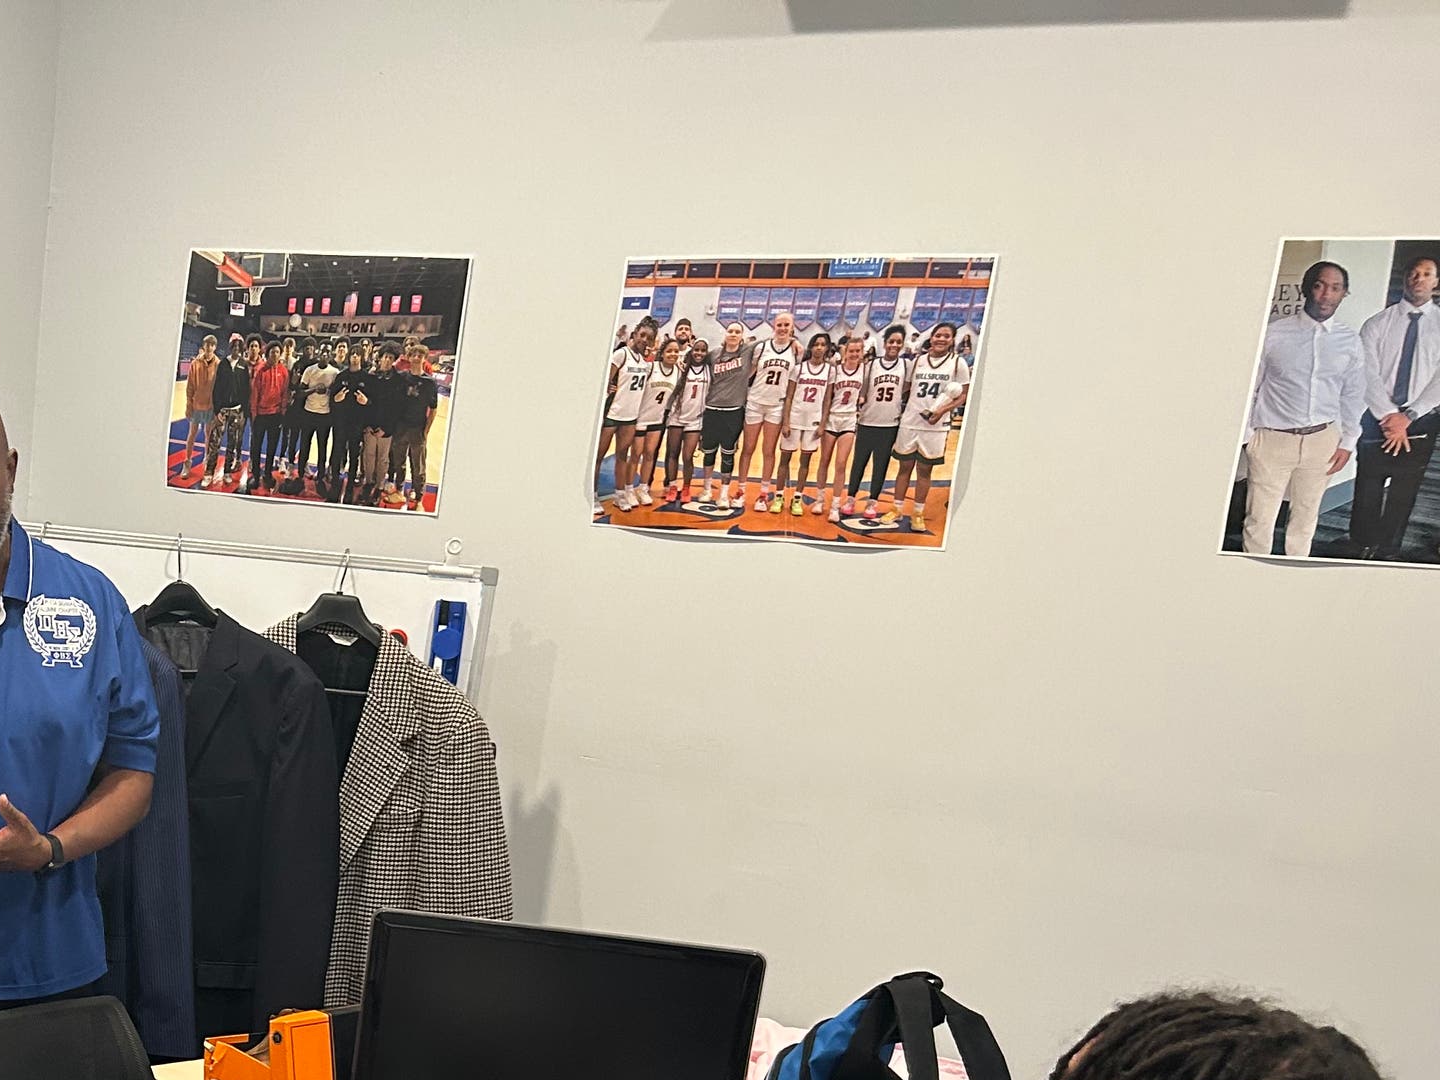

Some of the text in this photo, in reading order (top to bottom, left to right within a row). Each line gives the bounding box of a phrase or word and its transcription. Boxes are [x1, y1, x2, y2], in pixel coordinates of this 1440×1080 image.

[713, 358, 742, 374] EFFORT
[629, 375, 646, 391] 24
[765, 371, 782, 385] 21
[873, 374, 900, 387] BEECH
[655, 391, 665, 404] 4
[802, 386, 818, 403] 12
[876, 387, 895, 402] 35
[916, 382, 940, 399] 34
